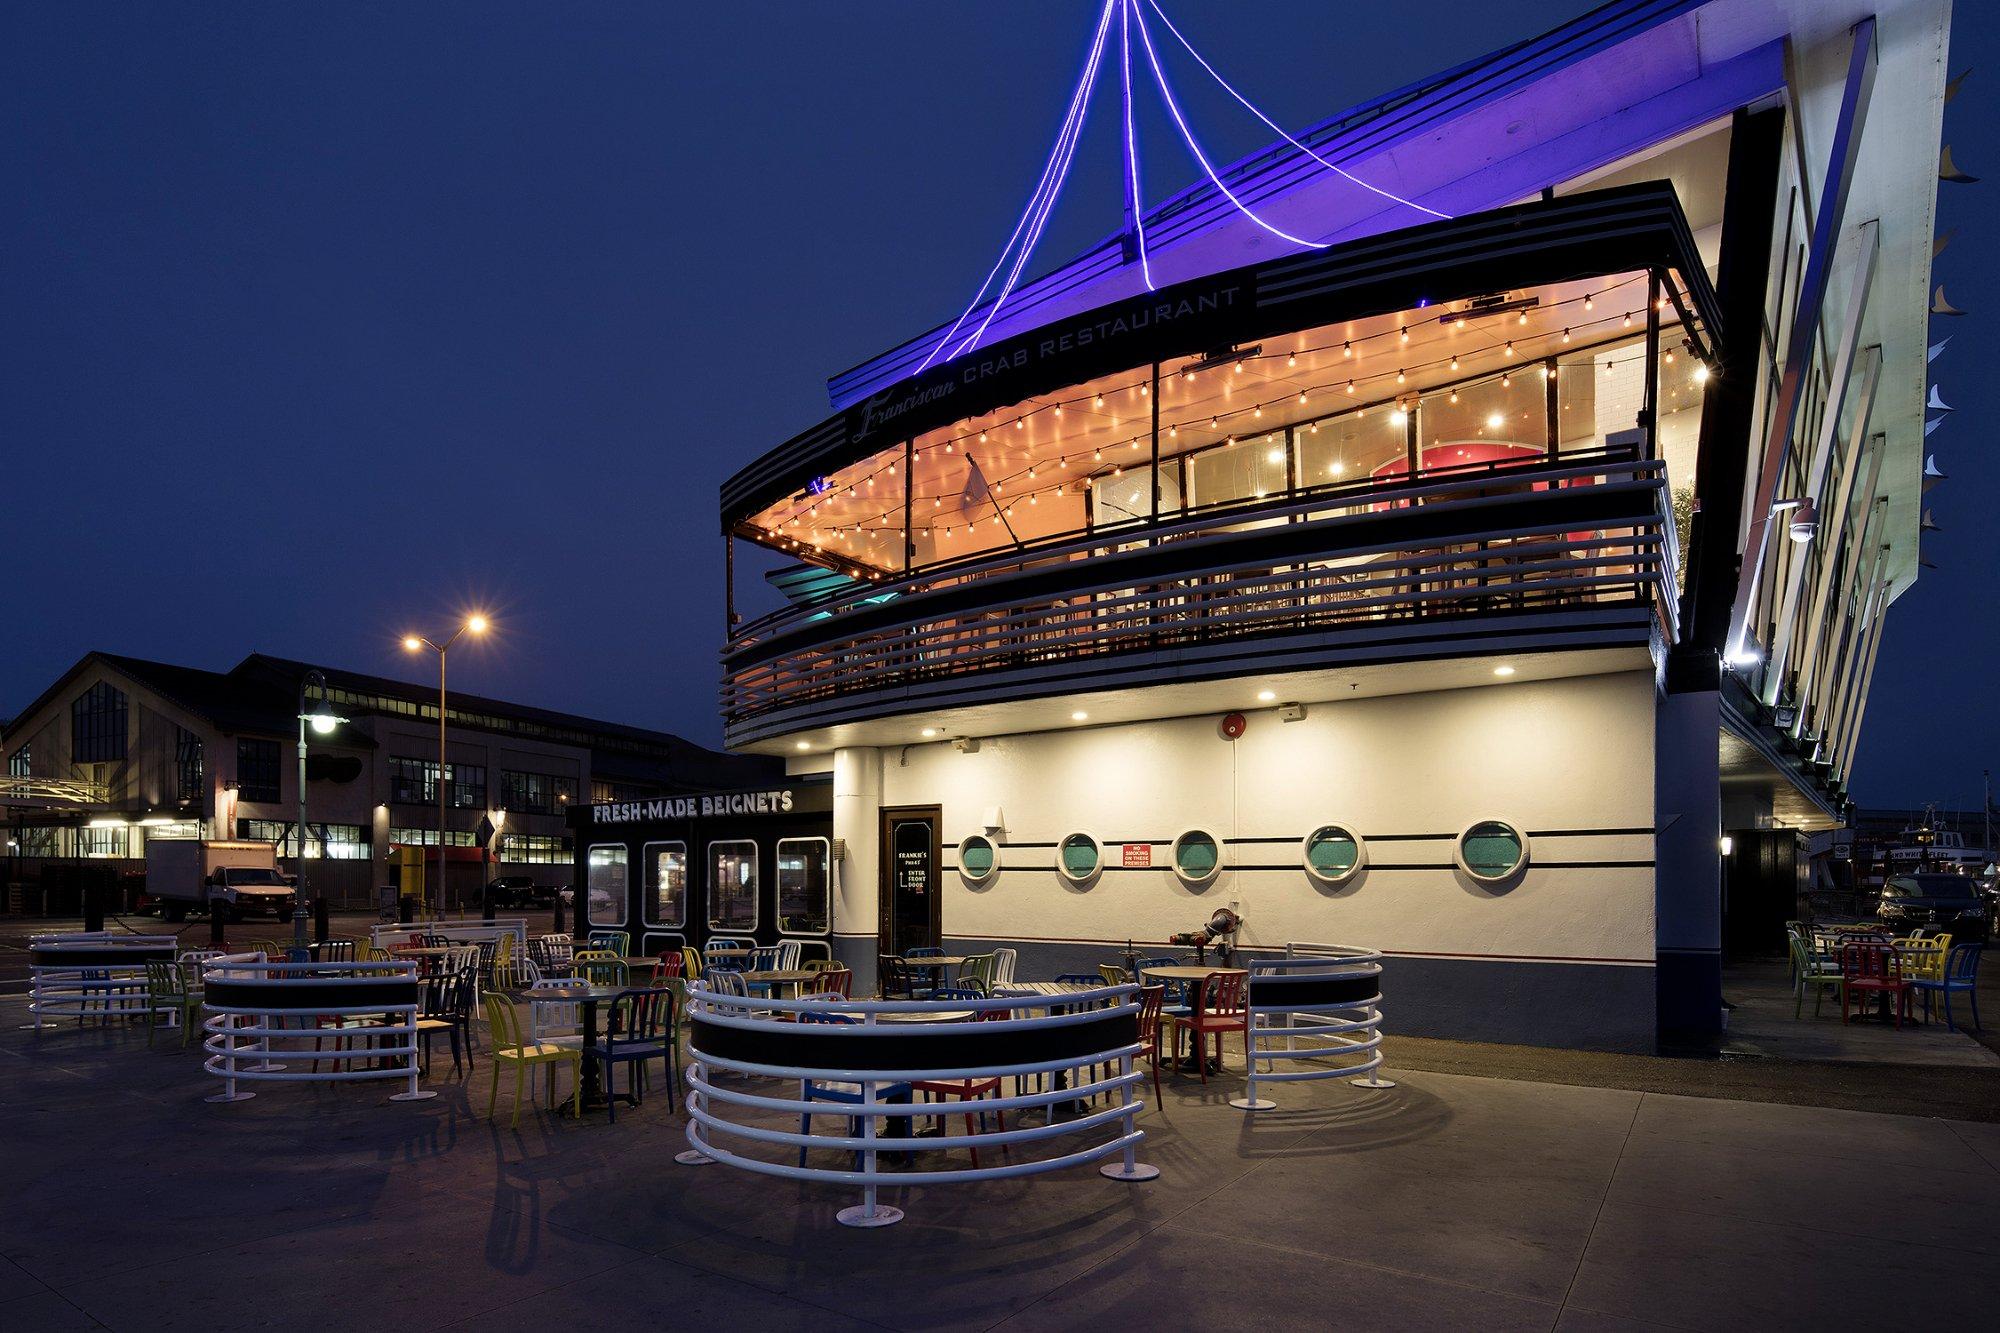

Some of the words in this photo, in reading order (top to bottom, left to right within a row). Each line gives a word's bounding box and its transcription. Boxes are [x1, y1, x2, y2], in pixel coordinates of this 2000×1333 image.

[852, 382, 957, 444] Franciscan
[963, 348, 1028, 385] CRAB
[1039, 286, 1239, 358] RESTAURANT
[592, 797, 697, 823] FRESH-MADE
[700, 790, 793, 817] BEIGNETS
[898, 851, 927, 859] FRANKIE'S
[1928, 851, 1949, 859] FLEET
